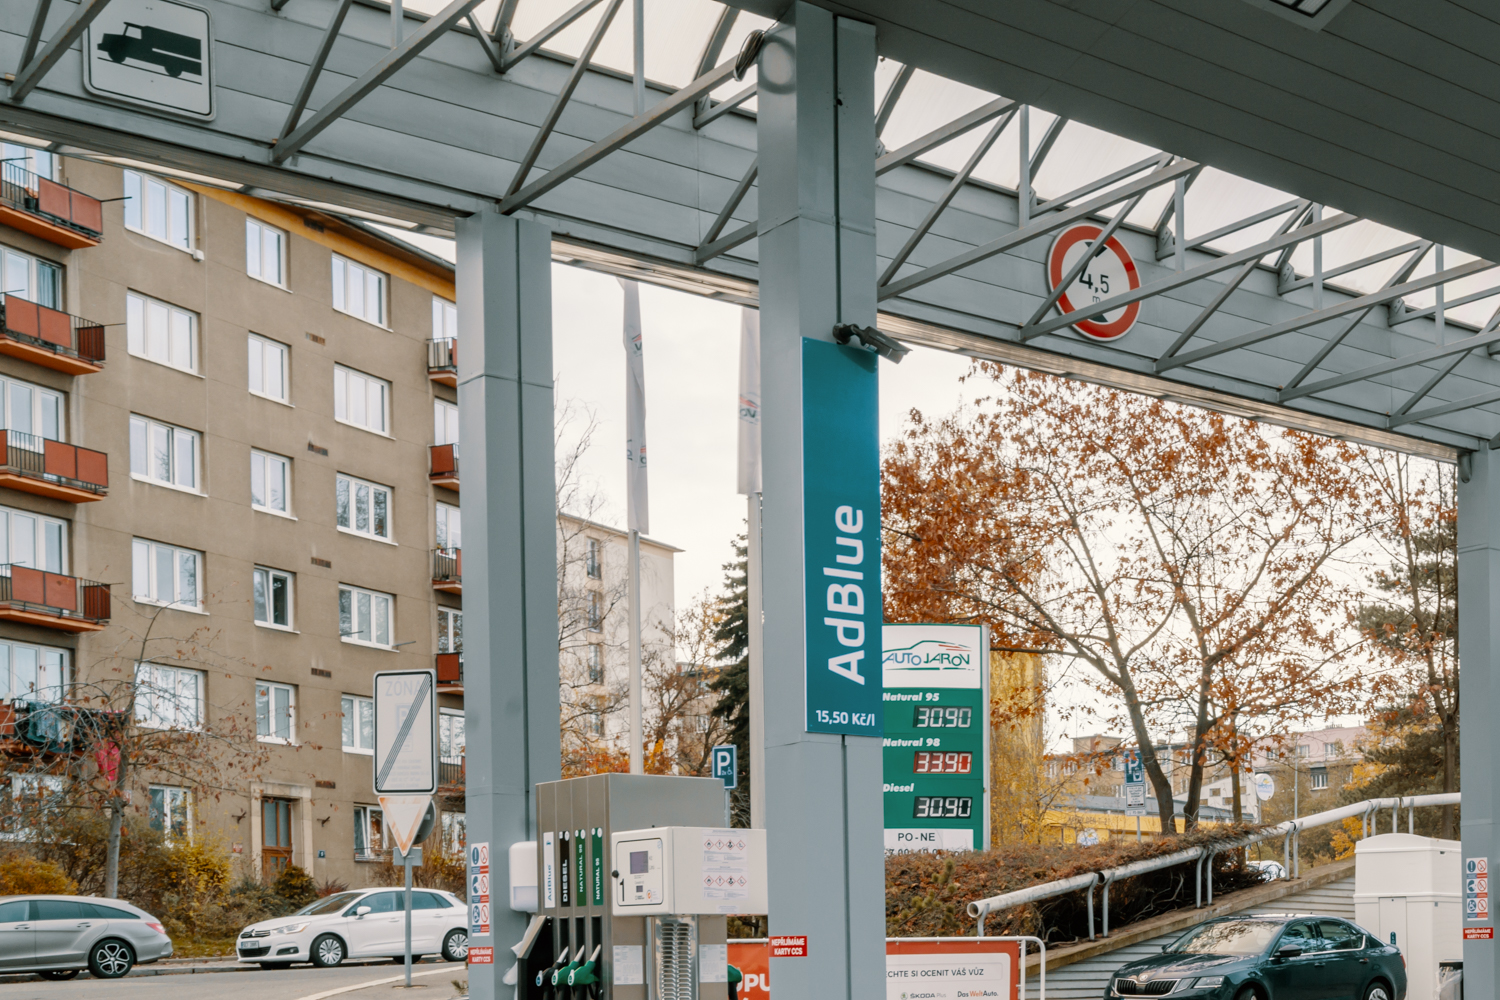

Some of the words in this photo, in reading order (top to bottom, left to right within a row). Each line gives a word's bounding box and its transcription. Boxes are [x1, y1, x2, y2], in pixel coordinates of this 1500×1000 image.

[823, 505, 865, 685] AdBlue
[882, 692, 922, 701] Natural
[925, 692, 940, 701] 95
[816, 709, 849, 725] 15,50
[851, 712, 875, 727] Kč/l
[916, 707, 972, 728] 30.90
[882, 738, 923, 747] Natural
[926, 738, 940, 747] 98
[717, 751, 731, 776] P
[916, 752, 972, 772] 33.90
[883, 783, 914, 792] Diesel
[916, 797, 972, 817] 30.90
[774, 947, 791, 956] KARTY
[920, 969, 949, 977] OCENIT
[951, 967, 966, 976] VÁŠ
[969, 966, 984, 976] VŮZ
[957, 990, 969, 998] Das
